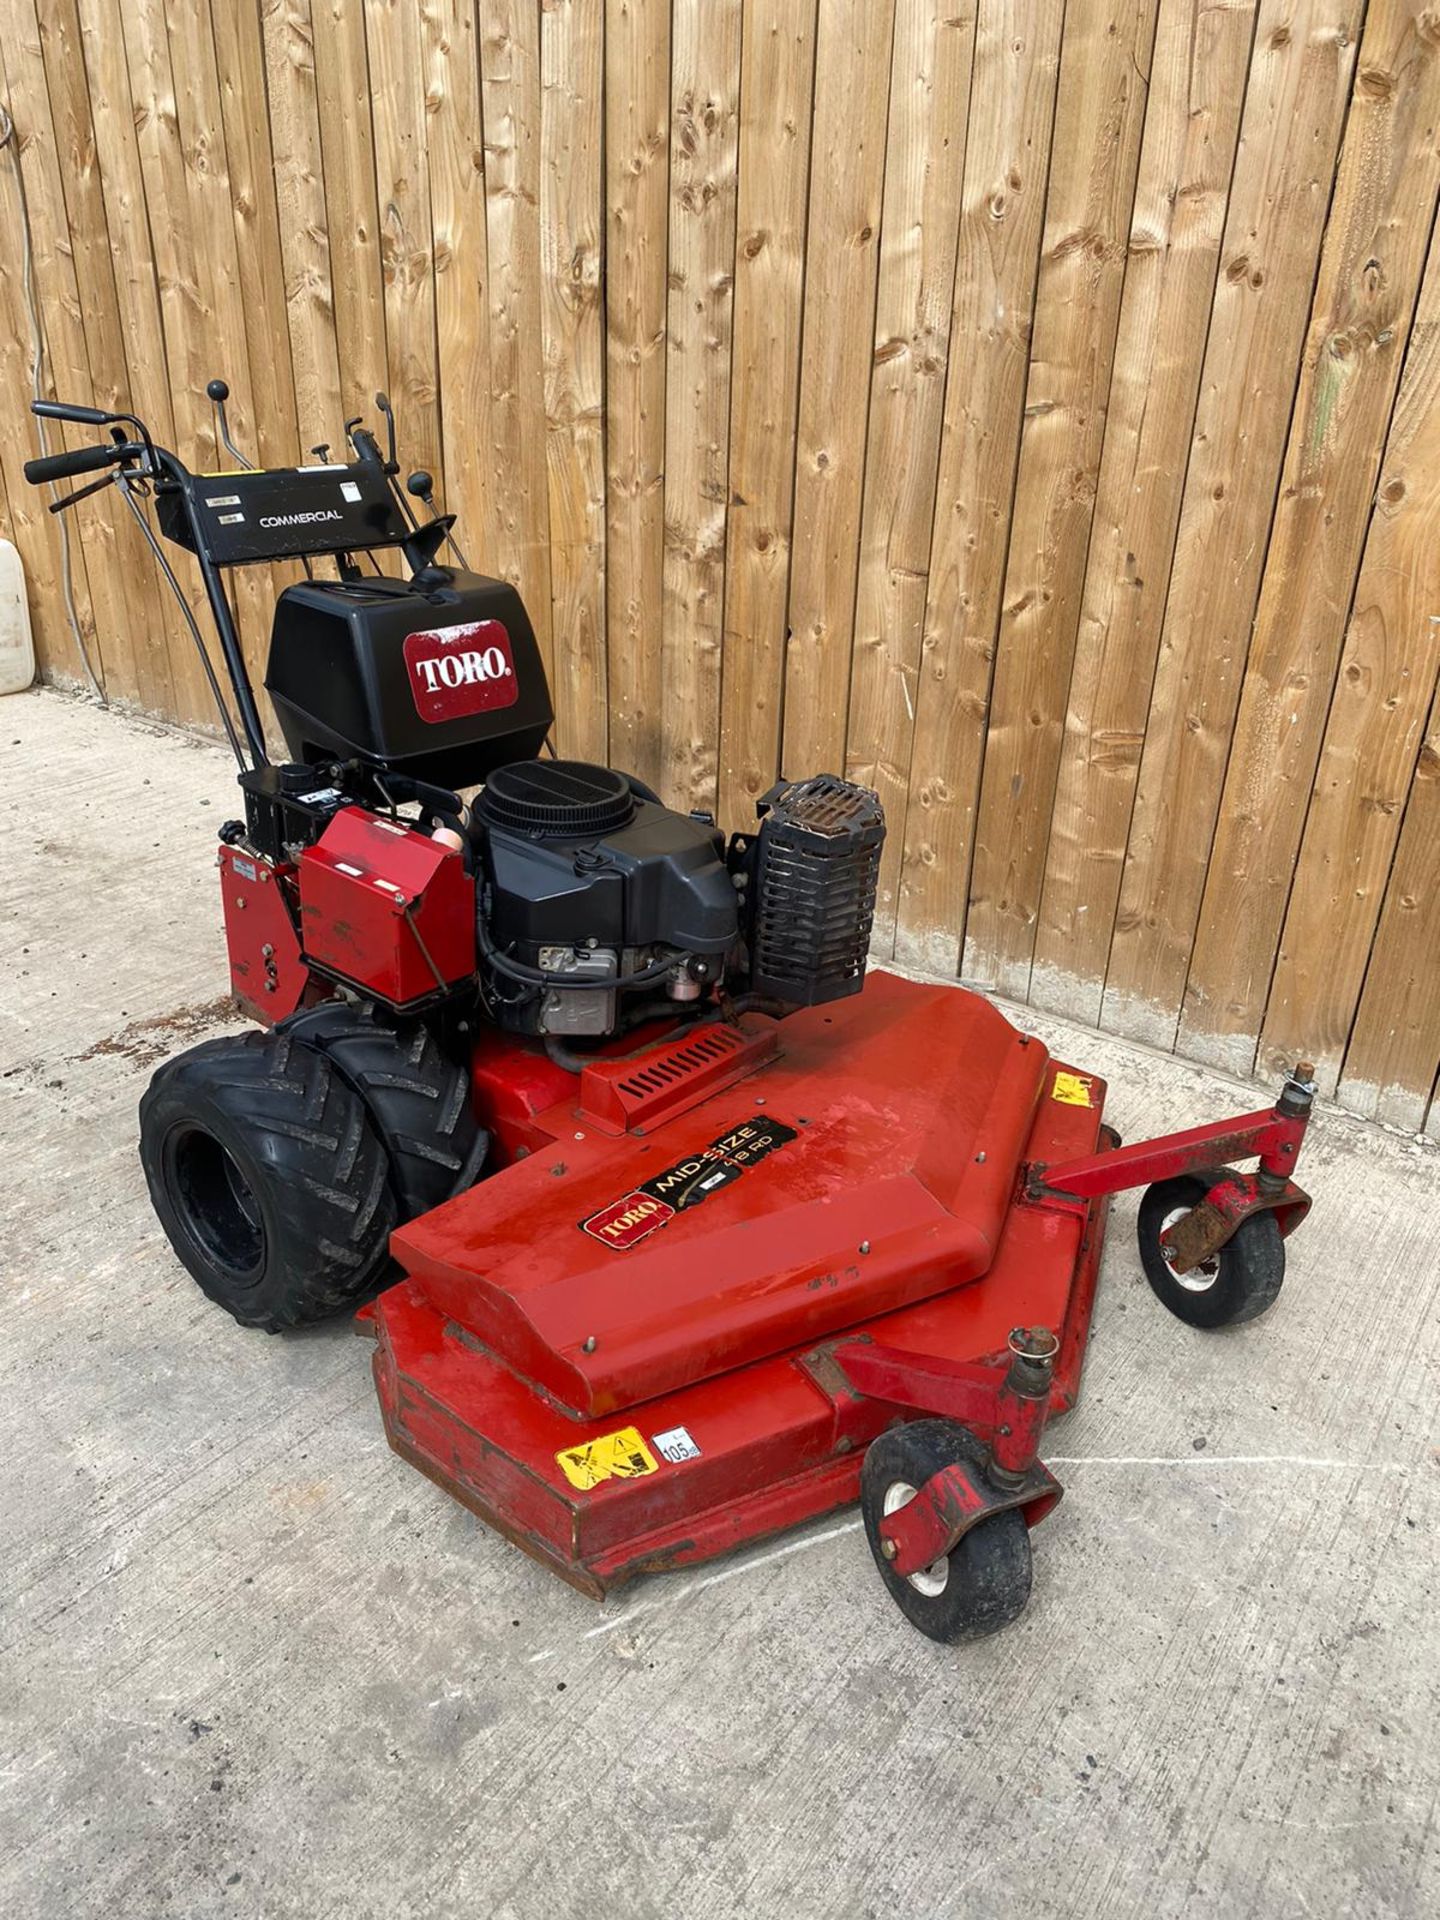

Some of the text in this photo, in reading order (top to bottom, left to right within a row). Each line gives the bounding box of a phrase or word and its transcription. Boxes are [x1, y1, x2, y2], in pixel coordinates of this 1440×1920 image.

[259, 509, 343, 528] COMMERCIAL
[748, 1135, 773, 1152] RD
[656, 1126, 758, 1193] MID-SIZE
[599, 1201, 658, 1238] TORO
[663, 1442, 689, 1463] 105
